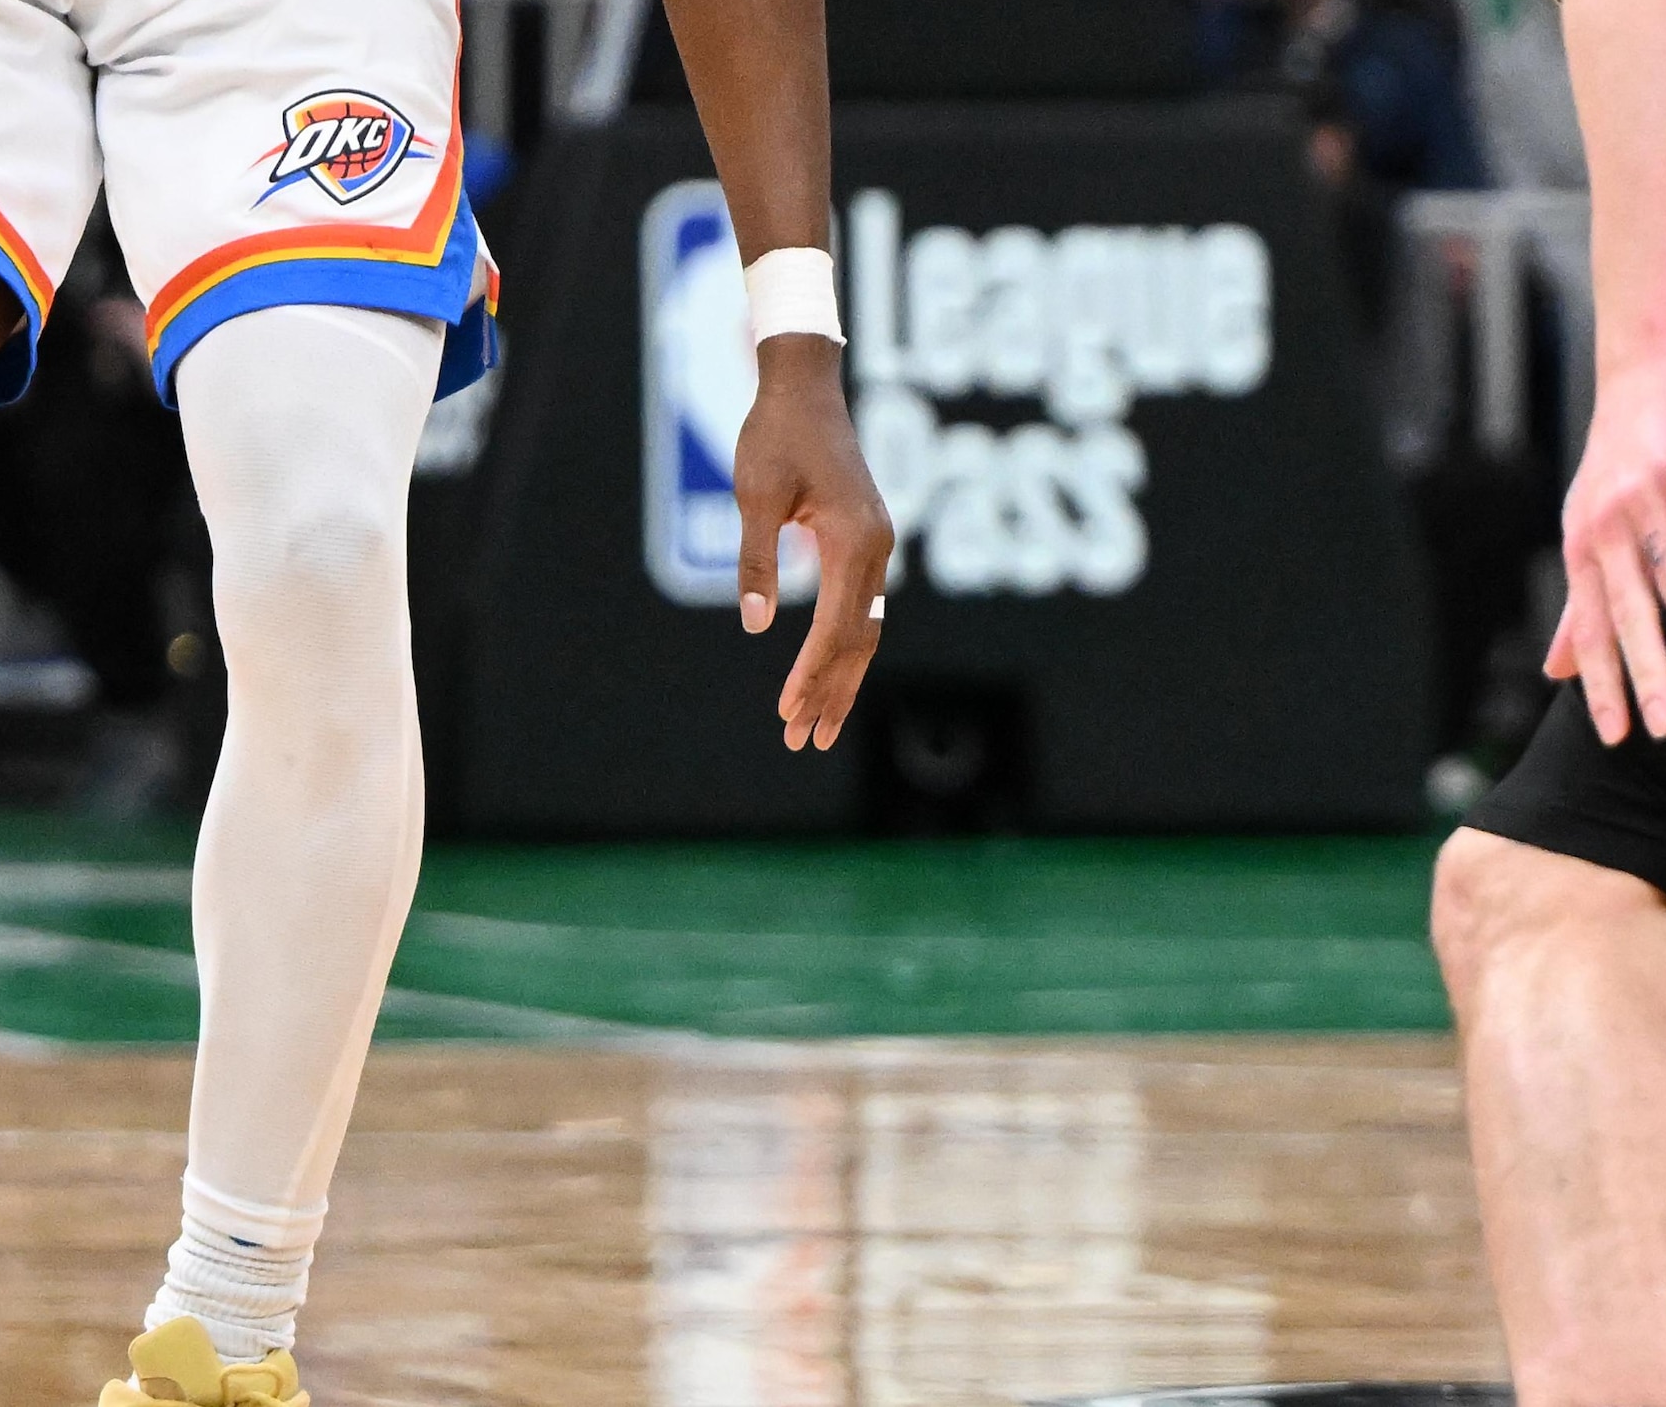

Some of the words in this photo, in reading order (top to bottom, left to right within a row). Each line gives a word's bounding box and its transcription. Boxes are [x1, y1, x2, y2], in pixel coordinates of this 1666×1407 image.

[271, 116, 390, 182] OKC
[848, 187, 1276, 430] League
[852, 390, 1149, 595] Pass
